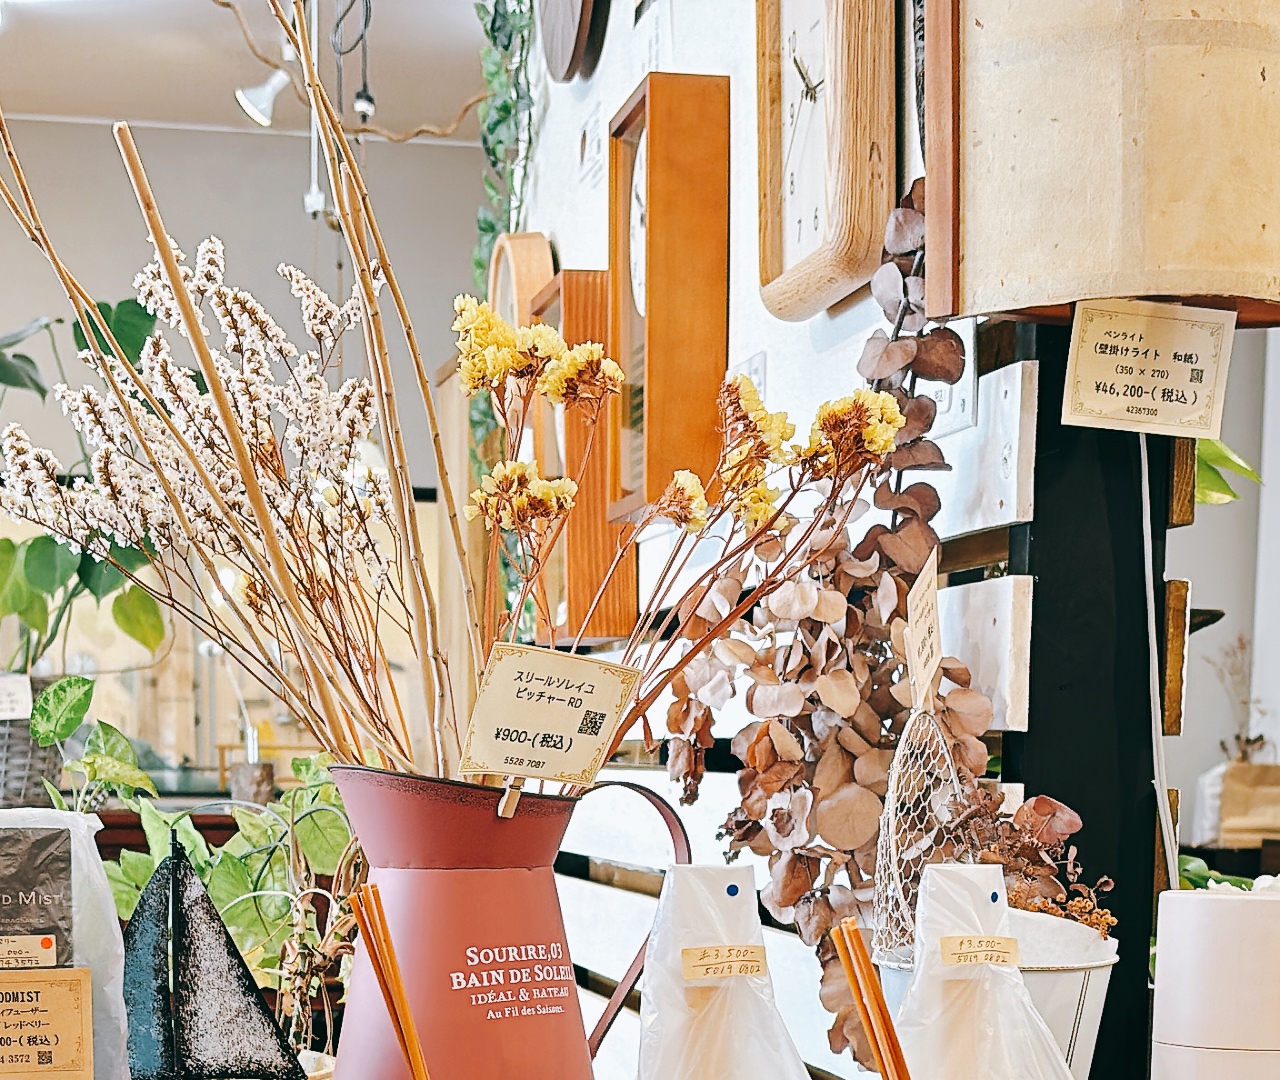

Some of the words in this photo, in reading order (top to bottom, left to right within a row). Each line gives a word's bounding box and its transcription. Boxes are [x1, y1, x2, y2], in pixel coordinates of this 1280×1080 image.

[1115, 364, 1134, 376] (350
[1150, 369, 1170, 380] 270)
[568, 696, 583, 709] RD
[504, 756, 524, 767] 5528
[449, 969, 505, 990] BAIN
[509, 967, 532, 984] DE
[471, 990, 516, 1006] IDÉAL
[519, 988, 530, 1002] &
[487, 1009, 502, 1020] Au
[505, 1006, 519, 1018] Fil
[521, 1005, 536, 1016] des
[4, 1019, 50, 1029] レッドベリー
[8, 1054, 31, 1063] 3572
